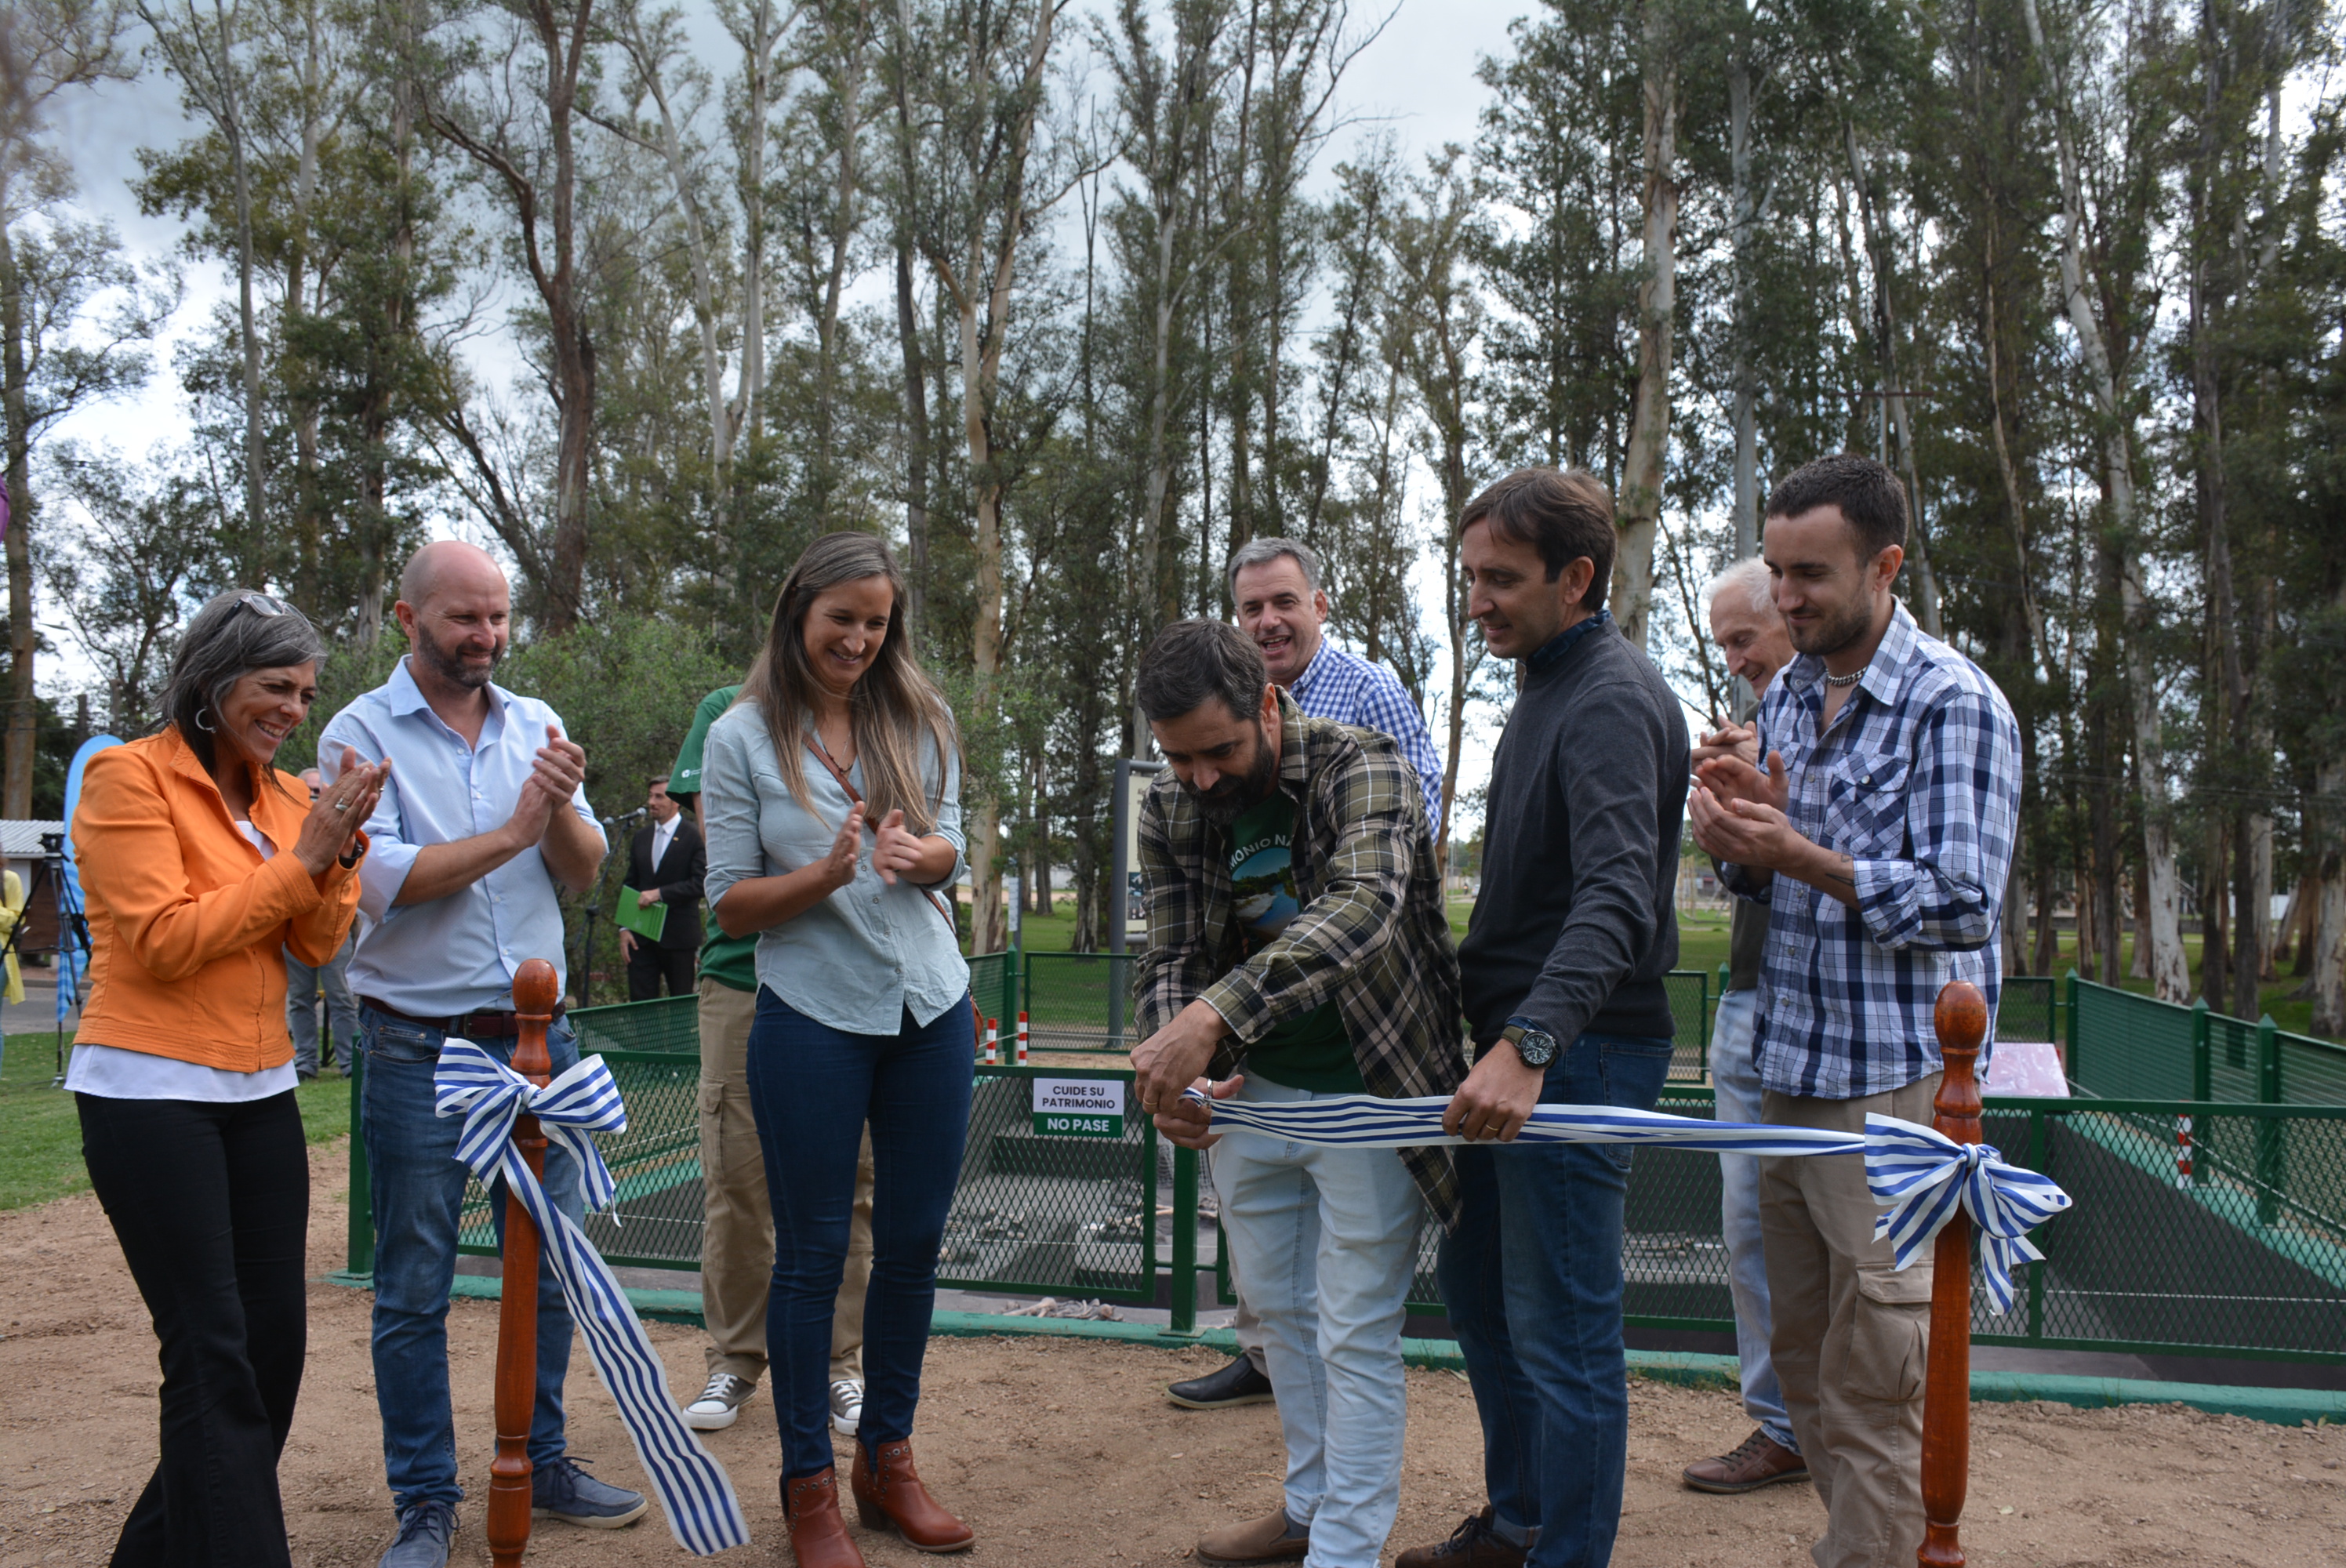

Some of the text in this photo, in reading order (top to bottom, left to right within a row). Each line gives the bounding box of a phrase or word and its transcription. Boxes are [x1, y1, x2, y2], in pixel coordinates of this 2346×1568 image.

[1053, 1086, 1105, 1097] CUIDE SU
[1042, 1098, 1115, 1109] PATRIMONIO
[1047, 1117, 1109, 1132] NO PASE
